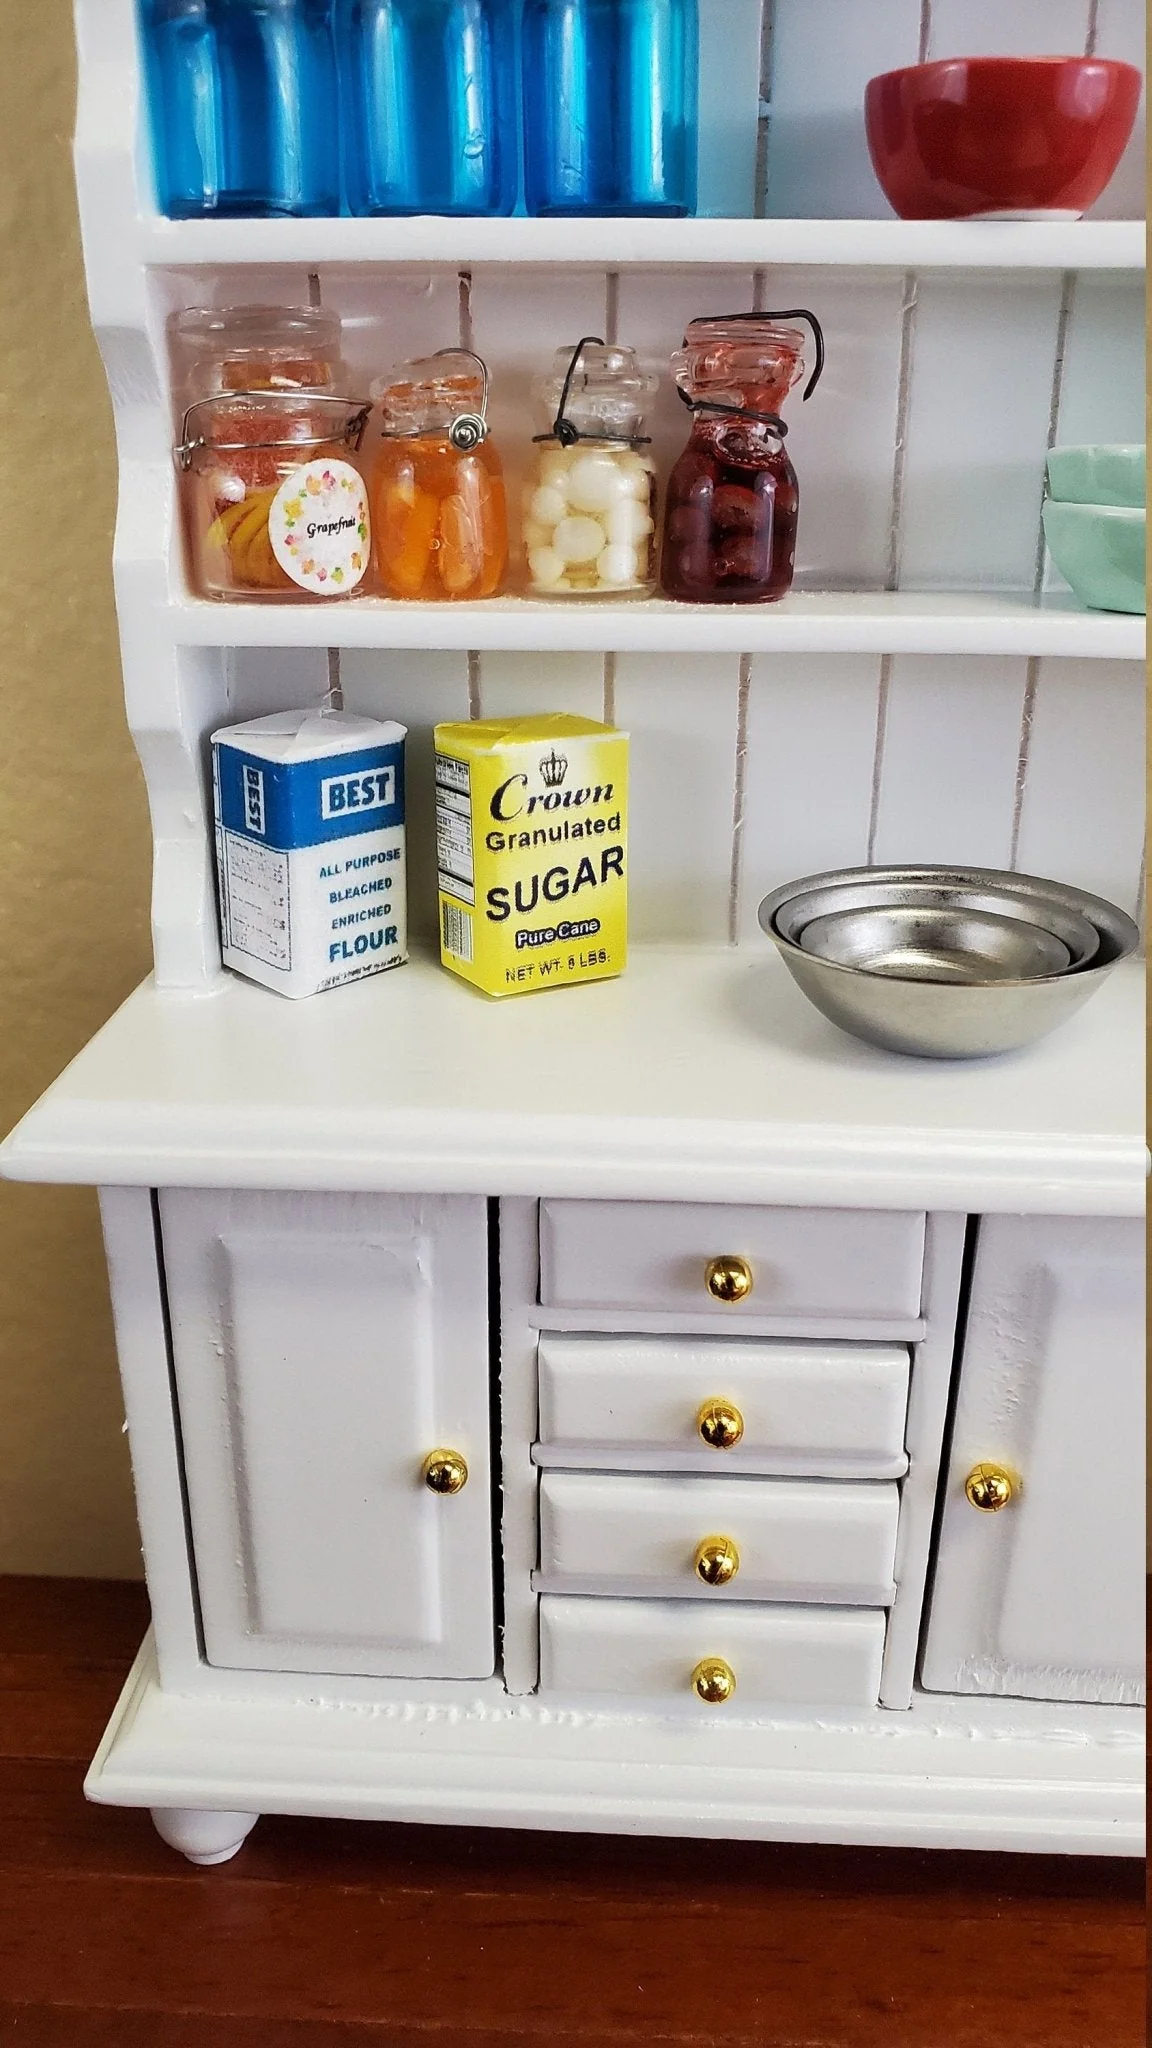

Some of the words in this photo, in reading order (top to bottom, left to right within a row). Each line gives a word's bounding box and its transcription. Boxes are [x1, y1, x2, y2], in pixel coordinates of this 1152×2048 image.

[246, 768, 262, 831] BEST
[329, 773, 391, 812] BEST
[489, 773, 615, 822] Crown
[486, 811, 621, 851] Granulated
[319, 864, 341, 878] ALL
[345, 848, 401, 872] PURPOSE
[329, 877, 392, 904] BLEACHED
[486, 845, 625, 922] SUGAR
[331, 903, 391, 930] ENRICHED
[516, 928, 555, 948] Pure
[558, 919, 599, 938] Cane
[329, 925, 398, 962] FLOUR
[506, 964, 534, 983] NET
